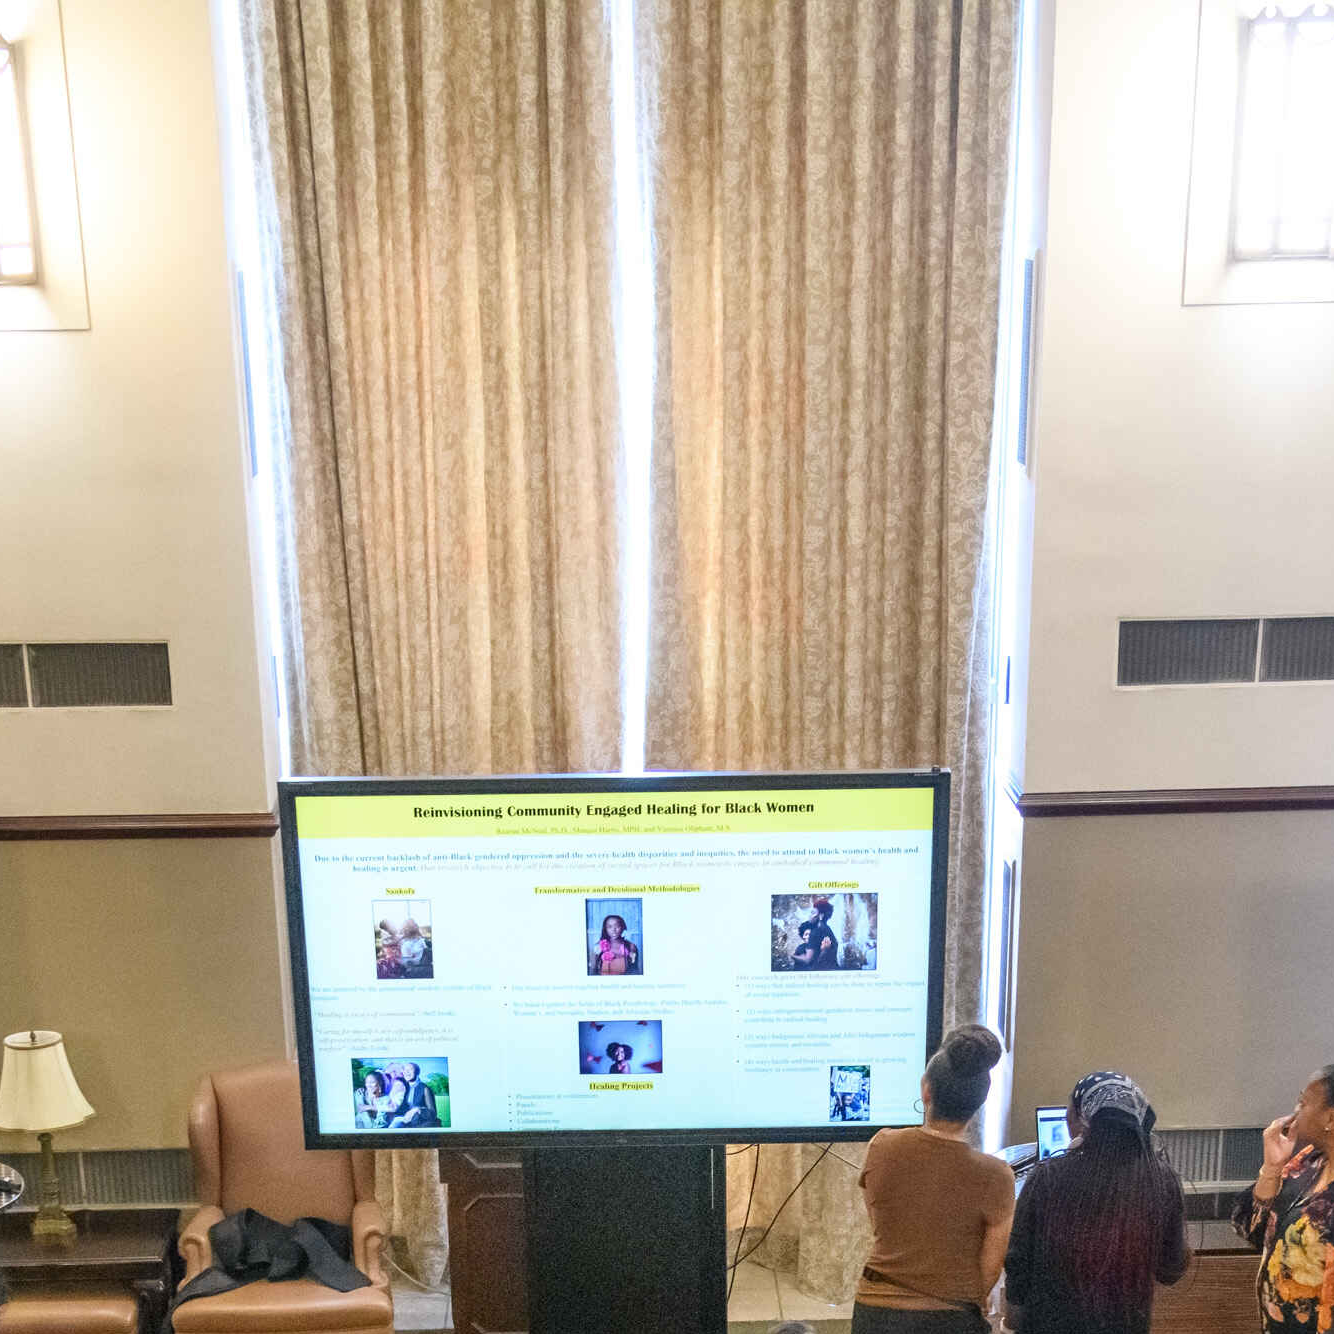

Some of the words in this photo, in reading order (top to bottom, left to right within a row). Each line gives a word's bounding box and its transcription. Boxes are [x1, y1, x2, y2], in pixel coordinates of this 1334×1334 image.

[413, 806, 503, 818] Reinvisioning
[507, 804, 582, 818] Community
[586, 804, 642, 817] Engaged
[647, 804, 697, 816] Healing
[701, 804, 721, 814] for
[725, 802, 762, 814] Black
[766, 802, 815, 813] Women
[314, 854, 330, 862] Due
[341, 854, 353, 862] the
[355, 854, 384, 862] current
[555, 851, 569, 859] and
[571, 851, 583, 859] the
[612, 850, 635, 858] health
[637, 849, 677, 859] disparities
[680, 849, 694, 857] and
[737, 848, 749, 856] the
[752, 848, 769, 856] need
[782, 848, 805, 856] attend
[818, 847, 839, 855] Black
[878, 846, 901, 854] health
[904, 846, 919, 854] and
[353, 864, 381, 873] healing
[534, 886, 590, 896] Transformative
[593, 886, 607, 894] and
[648, 884, 701, 894] Methodologies
[825, 880, 860, 890] Offerings
[385, 887, 415, 896] Sankofa
[589, 1082, 620, 1091] Healing
[621, 1082, 653, 1091] Projects
